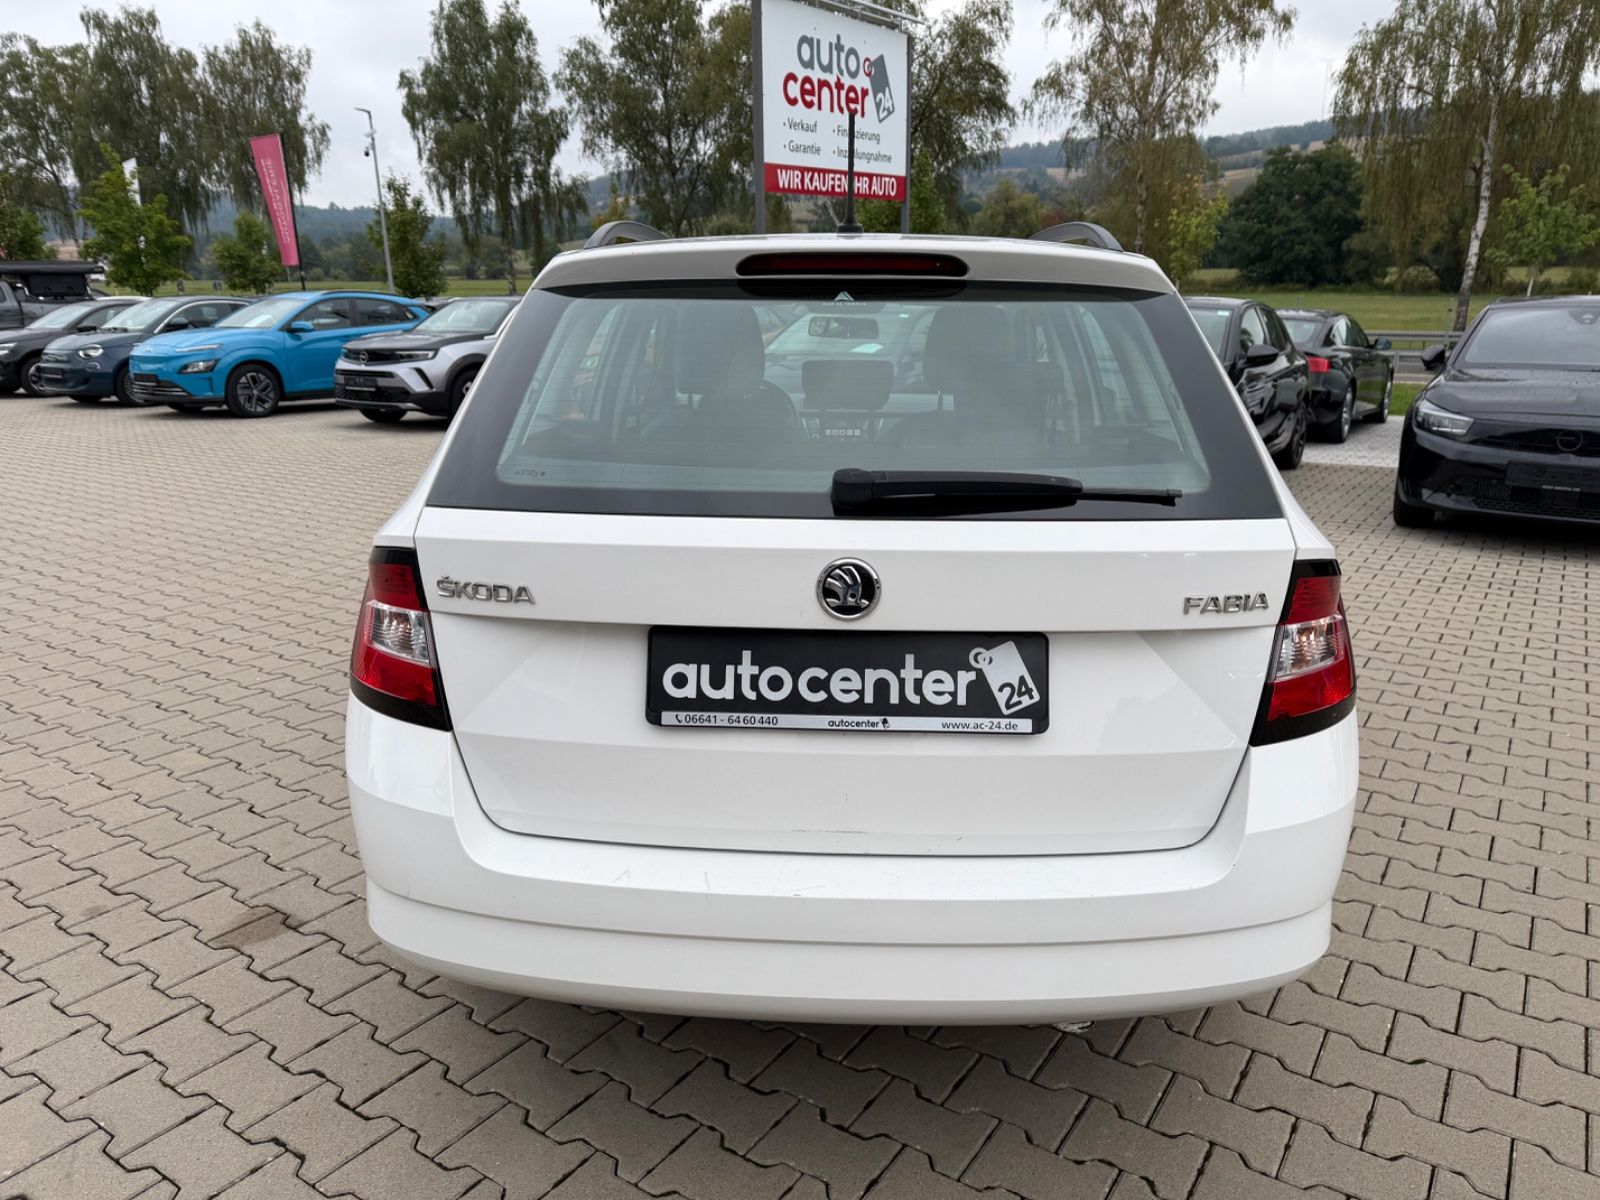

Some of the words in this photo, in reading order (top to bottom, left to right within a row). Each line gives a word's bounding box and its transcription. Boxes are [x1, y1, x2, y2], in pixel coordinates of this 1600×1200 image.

[797, 33, 860, 80] auto
[783, 71, 869, 119] center
[876, 86, 893, 117] 24
[788, 117, 818, 134] Verkauf
[837, 125, 881, 145] Finzierung
[788, 140, 821, 156] Garantie
[777, 168, 802, 190] WIR
[804, 172, 848, 193] KAUFEN
[852, 176, 869, 195] HR
[871, 177, 897, 197] AUTO
[436, 575, 536, 605] ŠKODA
[1182, 592, 1269, 615] FABIA
[662, 650, 977, 706] autocenter
[997, 674, 1035, 711] 24
[684, 714, 717, 724] 06641
[827, 718, 880, 728] autocenter
[941, 720, 1019, 731] www.ac-24.de
